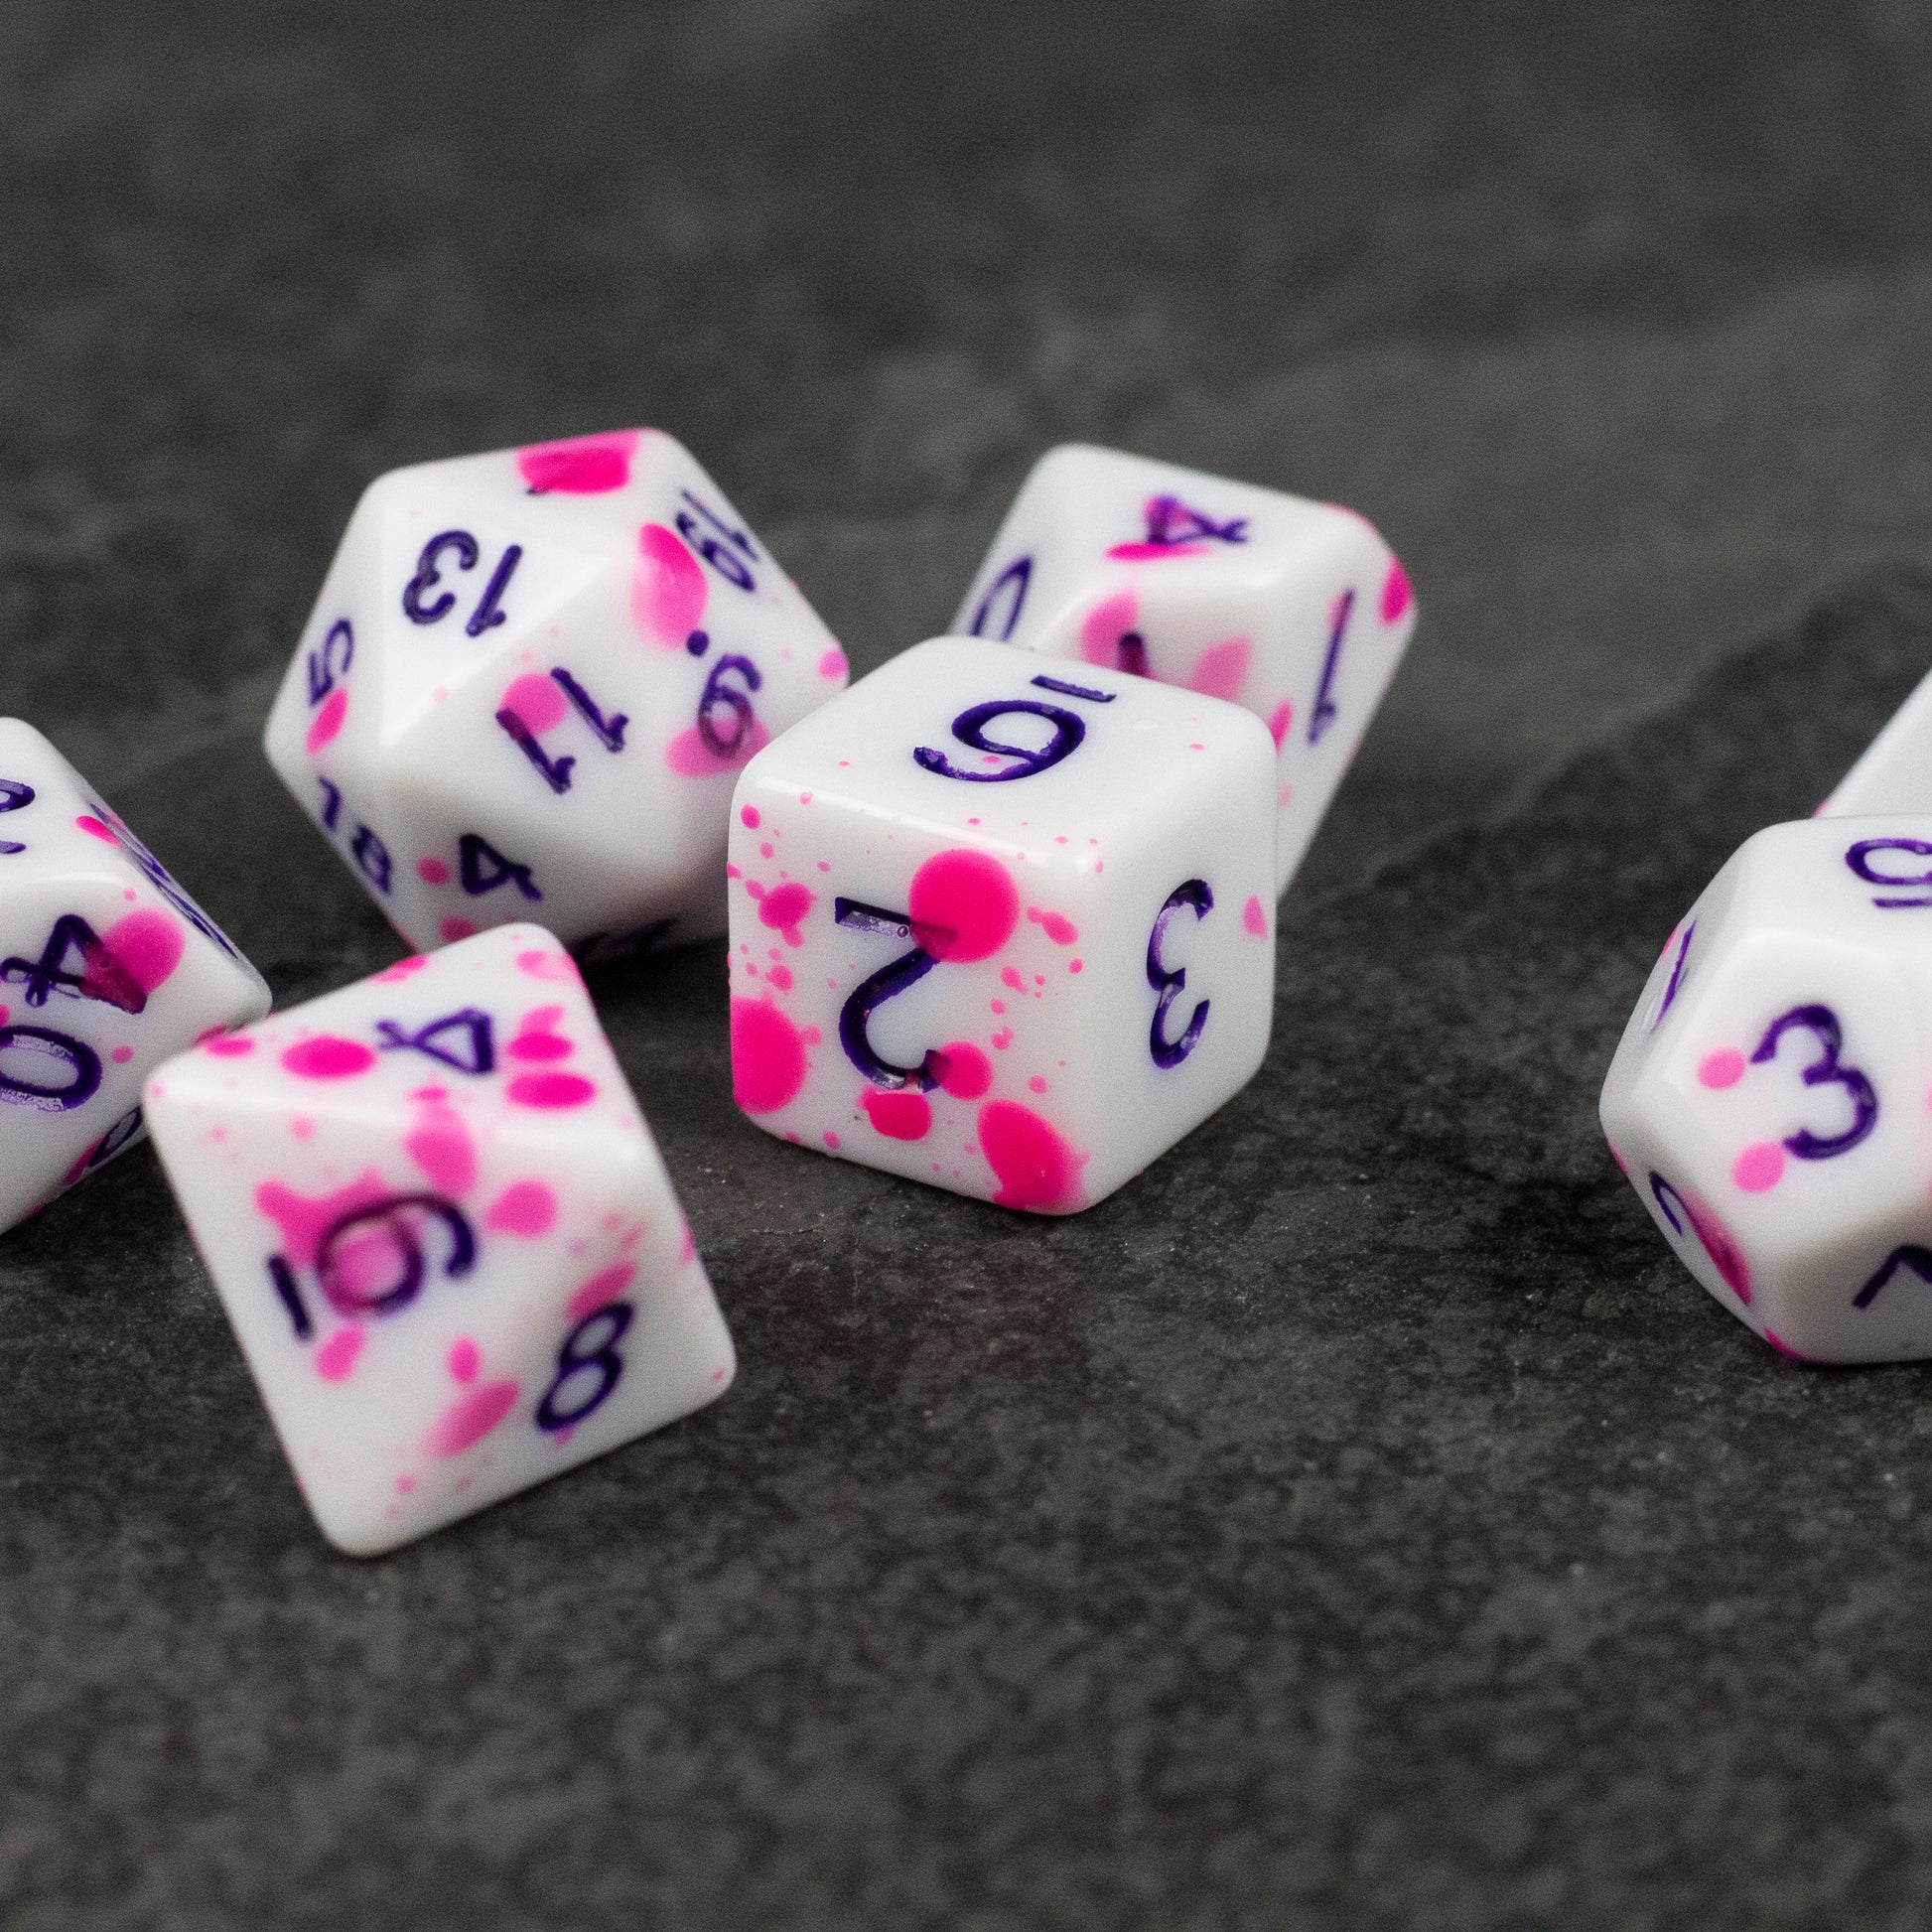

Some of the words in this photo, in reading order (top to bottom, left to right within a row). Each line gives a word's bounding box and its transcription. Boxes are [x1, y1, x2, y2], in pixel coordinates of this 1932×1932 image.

[1147, 495, 1249, 546] 4
[401, 529, 524, 638] 13
[307, 617, 355, 708] 5
[494, 667, 630, 796] 11
[458, 831, 545, 903] 4
[834, 896, 961, 1094] 2
[1146, 878, 1214, 1070] 3
[375, 1009, 497, 1078] 4
[1750, 1002, 1880, 1162] 3
[534, 1300, 635, 1434] 8
